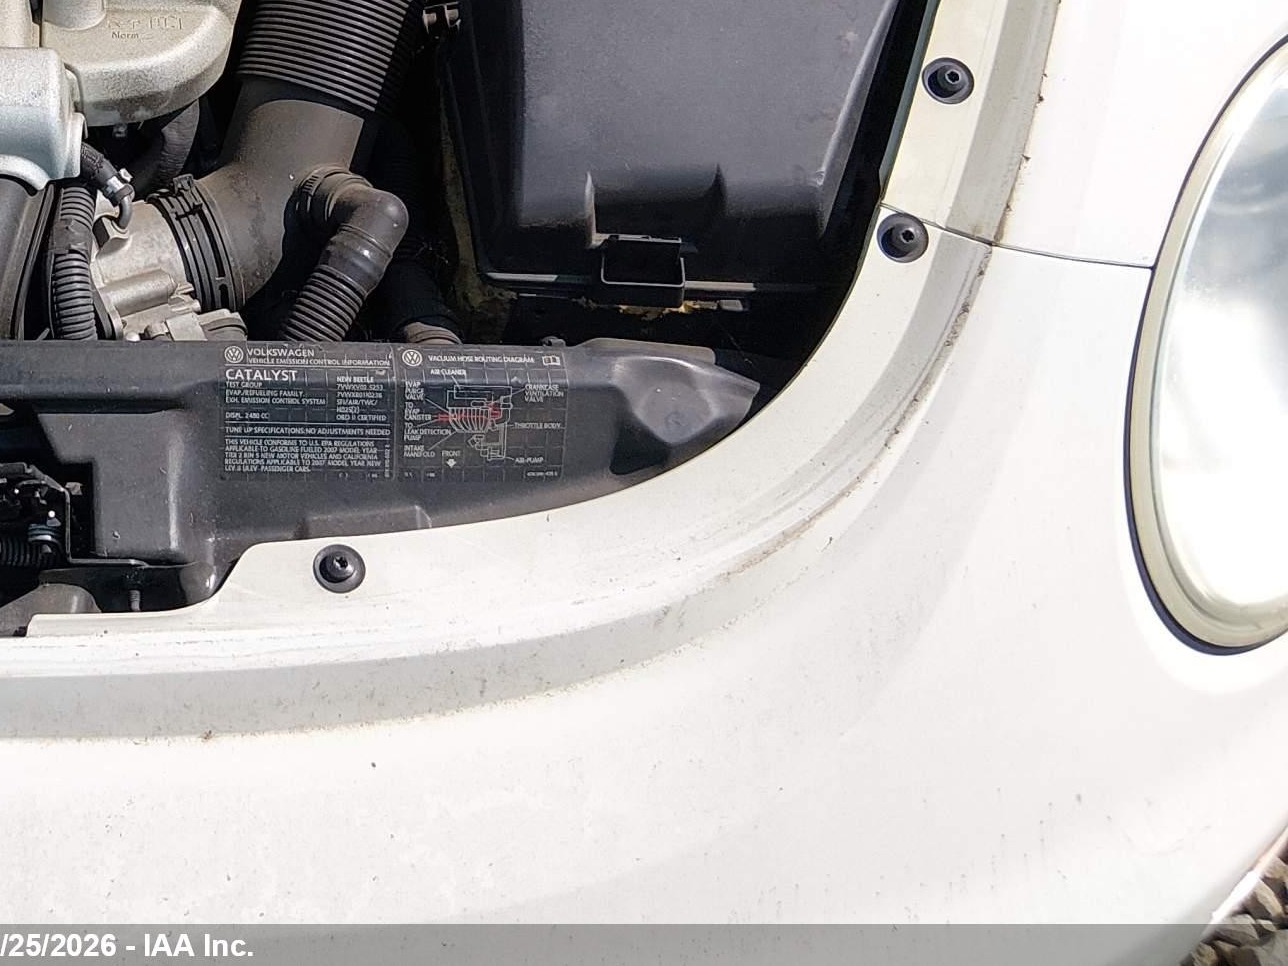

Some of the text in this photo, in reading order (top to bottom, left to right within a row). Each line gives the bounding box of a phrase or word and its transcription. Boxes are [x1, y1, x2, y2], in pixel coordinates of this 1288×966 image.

[111, 30, 139, 39] Norm
[247, 348, 315, 357] VOLKSWAGEN
[225, 369, 298, 381] CATALYST
